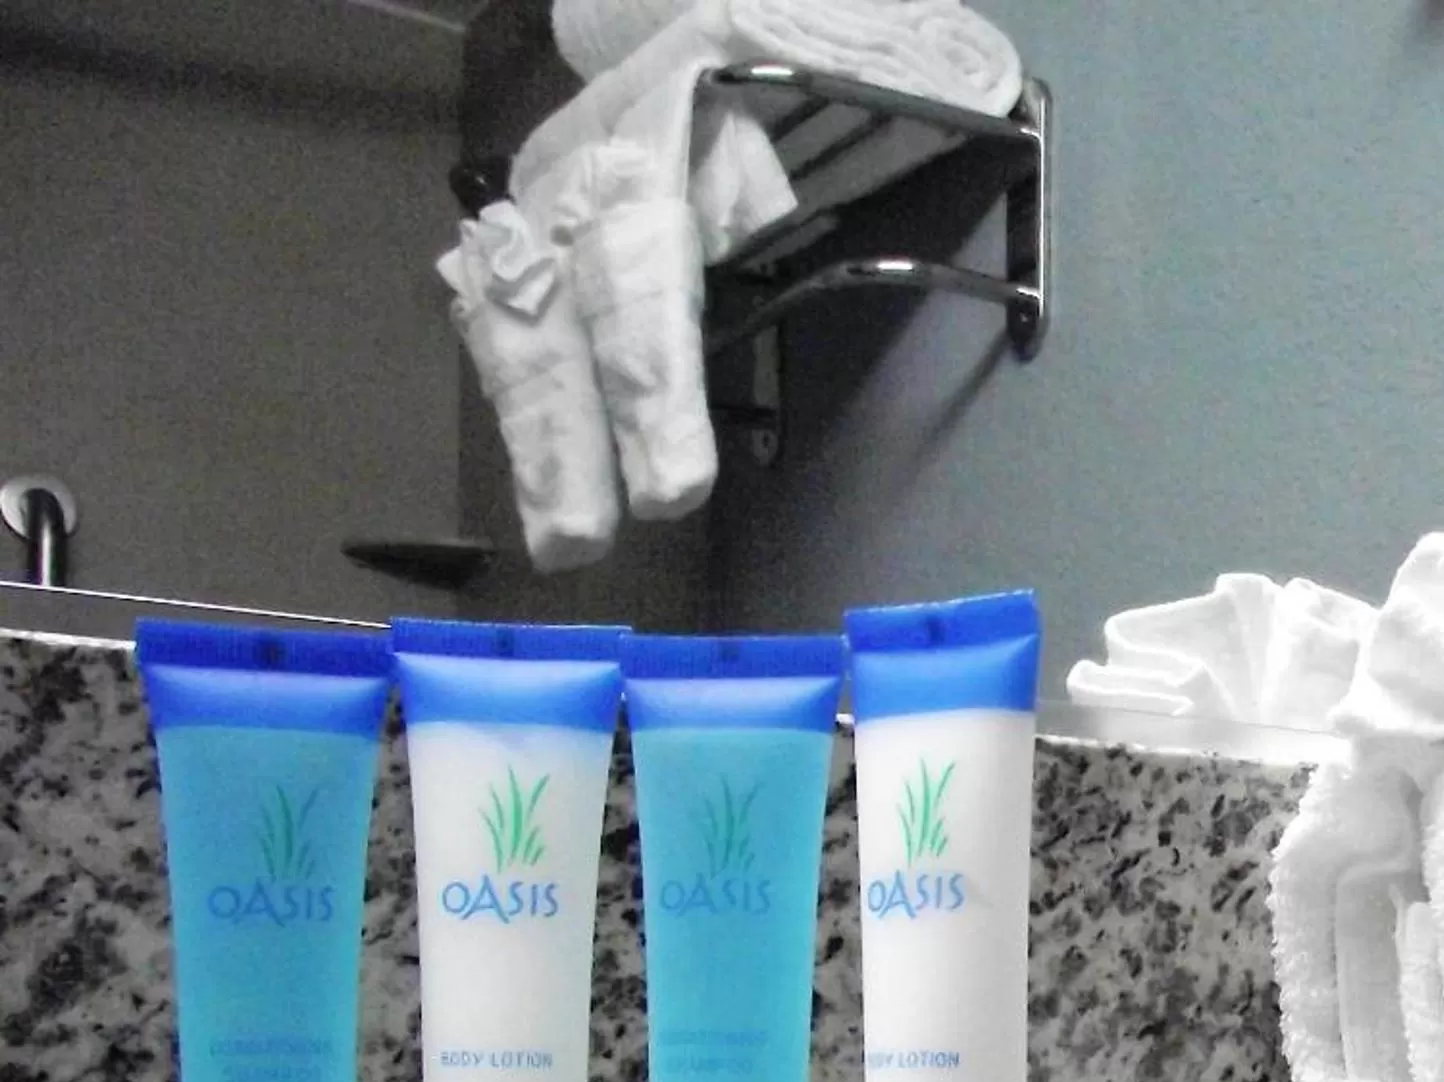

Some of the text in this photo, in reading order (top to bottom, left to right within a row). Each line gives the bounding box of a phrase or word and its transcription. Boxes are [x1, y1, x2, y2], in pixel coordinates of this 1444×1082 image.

[208, 877, 335, 928] OASIS
[442, 873, 559, 924] OASIS
[660, 872, 772, 917] OASIS
[867, 869, 965, 919] OASIS
[440, 1051, 553, 1068] BODY LOTION
[898, 1051, 960, 1068] LOTION
